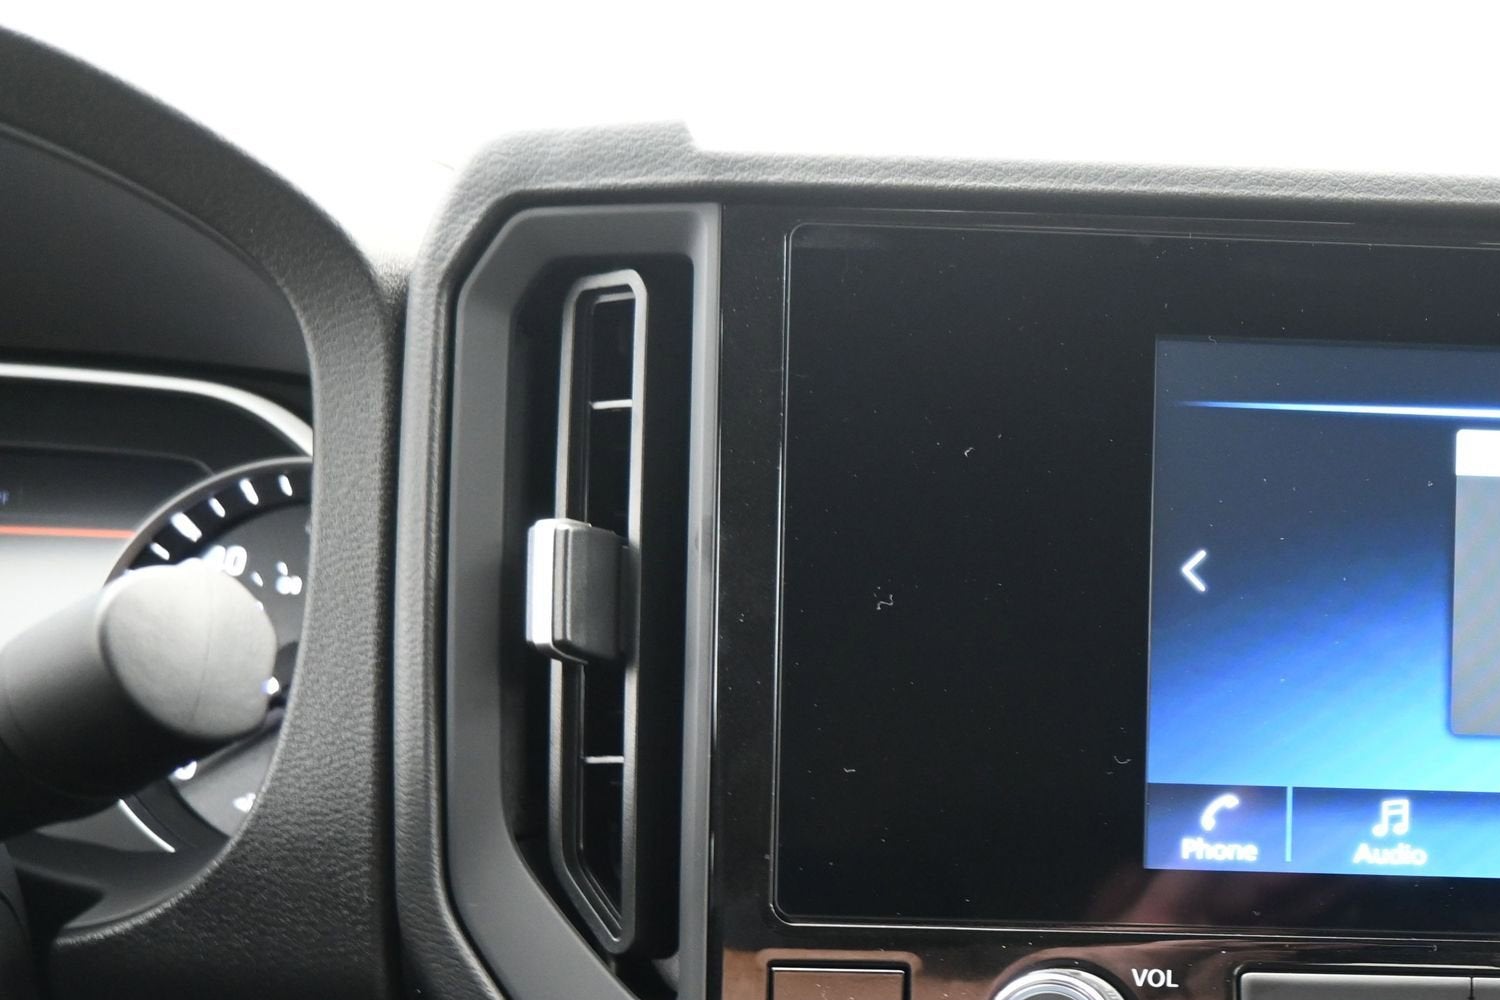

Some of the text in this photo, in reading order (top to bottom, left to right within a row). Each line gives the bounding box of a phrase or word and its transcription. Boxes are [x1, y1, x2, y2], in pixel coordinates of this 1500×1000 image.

[1180, 837, 1258, 862] Phone
[1352, 843, 1428, 867] Audio
[1131, 968, 1179, 989] VOL
